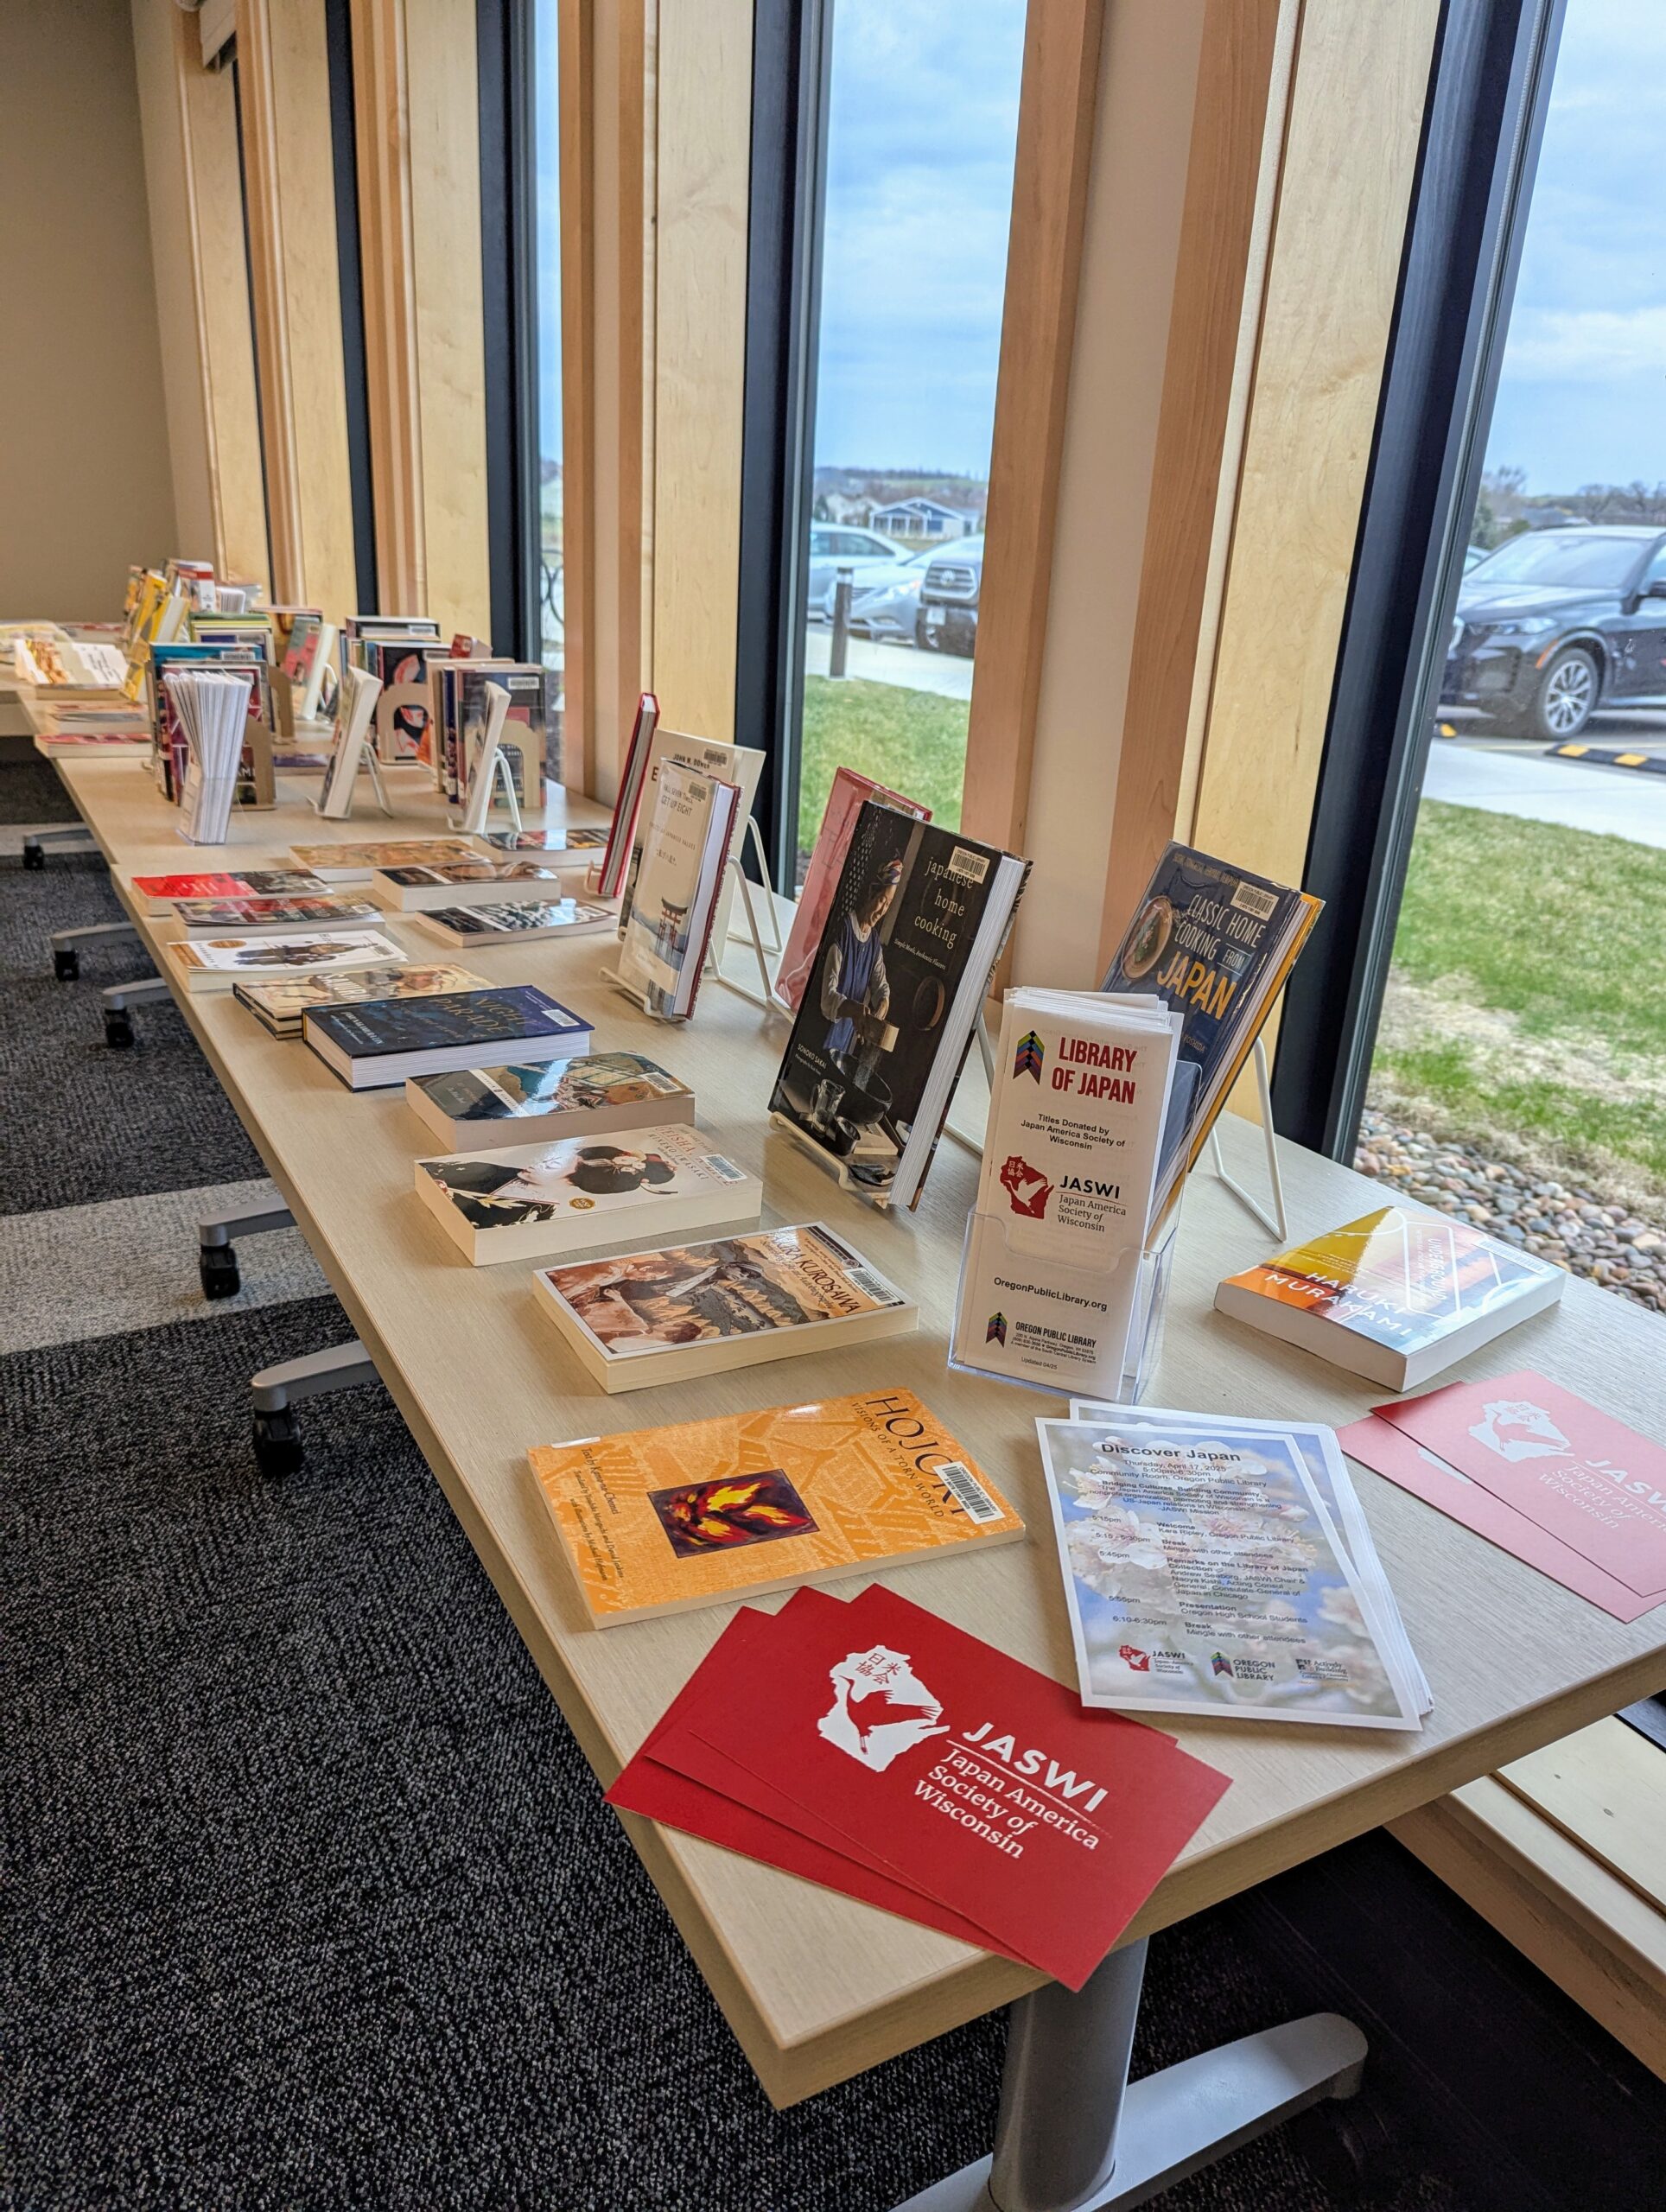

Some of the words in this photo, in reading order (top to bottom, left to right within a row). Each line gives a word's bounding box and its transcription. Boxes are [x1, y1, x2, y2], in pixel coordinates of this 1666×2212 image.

[673, 753, 686, 763] JOHN
[677, 804, 693, 817] EIGHT
[934, 887, 965, 917] home
[1187, 893, 1230, 931] CLASSIC
[1225, 912, 1267, 949] HOME
[914, 916, 957, 950] cooking
[1174, 920, 1221, 961] COOKING
[1222, 949, 1246, 969] FROM
[915, 950, 933, 963] Authentic
[1156, 950, 1237, 1020] JAPAN
[429, 997, 513, 1035] PARADE
[475, 995, 537, 1027] NIGHT
[1059, 1037, 1138, 1073] LIBRARY
[1052, 1066, 1076, 1093] OF
[1077, 1072, 1136, 1105] JAPAN
[1021, 1119, 1045, 1132] Japan
[1046, 1125, 1081, 1139] America
[1083, 1132, 1115, 1147] Society
[1038, 1113, 1060, 1125] Titles
[1061, 1119, 1097, 1133] Donated
[1098, 1127, 1110, 1136] by
[1049, 1135, 1092, 1151] Wisconsin
[676, 1154, 709, 1180] IWASAKI
[1059, 1175, 1121, 1199] JASWI
[1059, 1194, 1085, 1208] Japan
[1087, 1200, 1127, 1216] America
[1059, 1205, 1092, 1221] Society
[1093, 1213, 1104, 1223] of
[1057, 1214, 1105, 1233] Wisconsin
[795, 1259, 862, 1314] KUROSAWA
[994, 1277, 1108, 1312] OregonPublicLibrary.org
[1305, 1271, 1407, 1315] HARUKI
[1264, 1273, 1414, 1337] MURAKAMI
[1015, 1321, 1042, 1336] OREGON
[1043, 1327, 1067, 1342] PUBLIC
[1067, 1333, 1097, 1349] LIBRARY
[1021, 1357, 1042, 1367] Updated
[851, 1402, 881, 1433] VISIONS
[877, 1433, 892, 1445] OF
[894, 1455, 919, 1480] TORN
[914, 1482, 945, 1518] WORLD
[1101, 1443, 1180, 1458] Discover
[1186, 1449, 1241, 1462] Japan
[1124, 1459, 1166, 1468] Thursday,
[1167, 1462, 1186, 1471] April
[1142, 1466, 1211, 1478] 5:00pm-6:30pm
[1091, 1468, 1139, 1479] Community
[1173, 1474, 1207, 1484] Oregon
[1207, 1477, 1235, 1485] Public
[1237, 1478, 1267, 1488] Library
[1566, 1465, 1613, 1495] Japan
[1538, 1473, 1619, 1529] Wisconsin
[1552, 1470, 1611, 1507] Society
[1610, 1509, 1631, 1519] of
[1092, 1515, 1122, 1523] 5:15pm
[1099, 1551, 1130, 1560] 5:45pm
[1167, 1557, 1205, 1566] Remarks
[1168, 1563, 1213, 1572] Collection
[1109, 1595, 1141, 1604] 5:55pm
[1211, 1585, 1291, 1596] Consulate-General
[1213, 1592, 1249, 1600] Chicago
[1179, 1601, 1237, 1611] Presentation
[1180, 1608, 1211, 1618] Oregon
[1212, 1610, 1236, 1619] High
[1269, 1615, 1308, 1624] Students
[1112, 1615, 1167, 1626] 6:10-6:30pm
[1186, 1629, 1216, 1638] Mingle
[868, 1652, 902, 1676] 日米
[1152, 1650, 1186, 1659] JASWI
[1233, 1659, 1276, 1669] OREGON
[855, 1660, 891, 1685] 協会
[1234, 1665, 1268, 1674] PUBLIC
[1236, 1672, 1275, 1681] LIBRARY
[962, 1721, 1110, 1813] JASWI
[928, 1765, 1009, 1821] Society
[1007, 1815, 1039, 1836] of
[941, 1748, 1006, 1793] Japan
[1006, 1785, 1100, 1849] America
[913, 1780, 1026, 1859] Wisconsin
